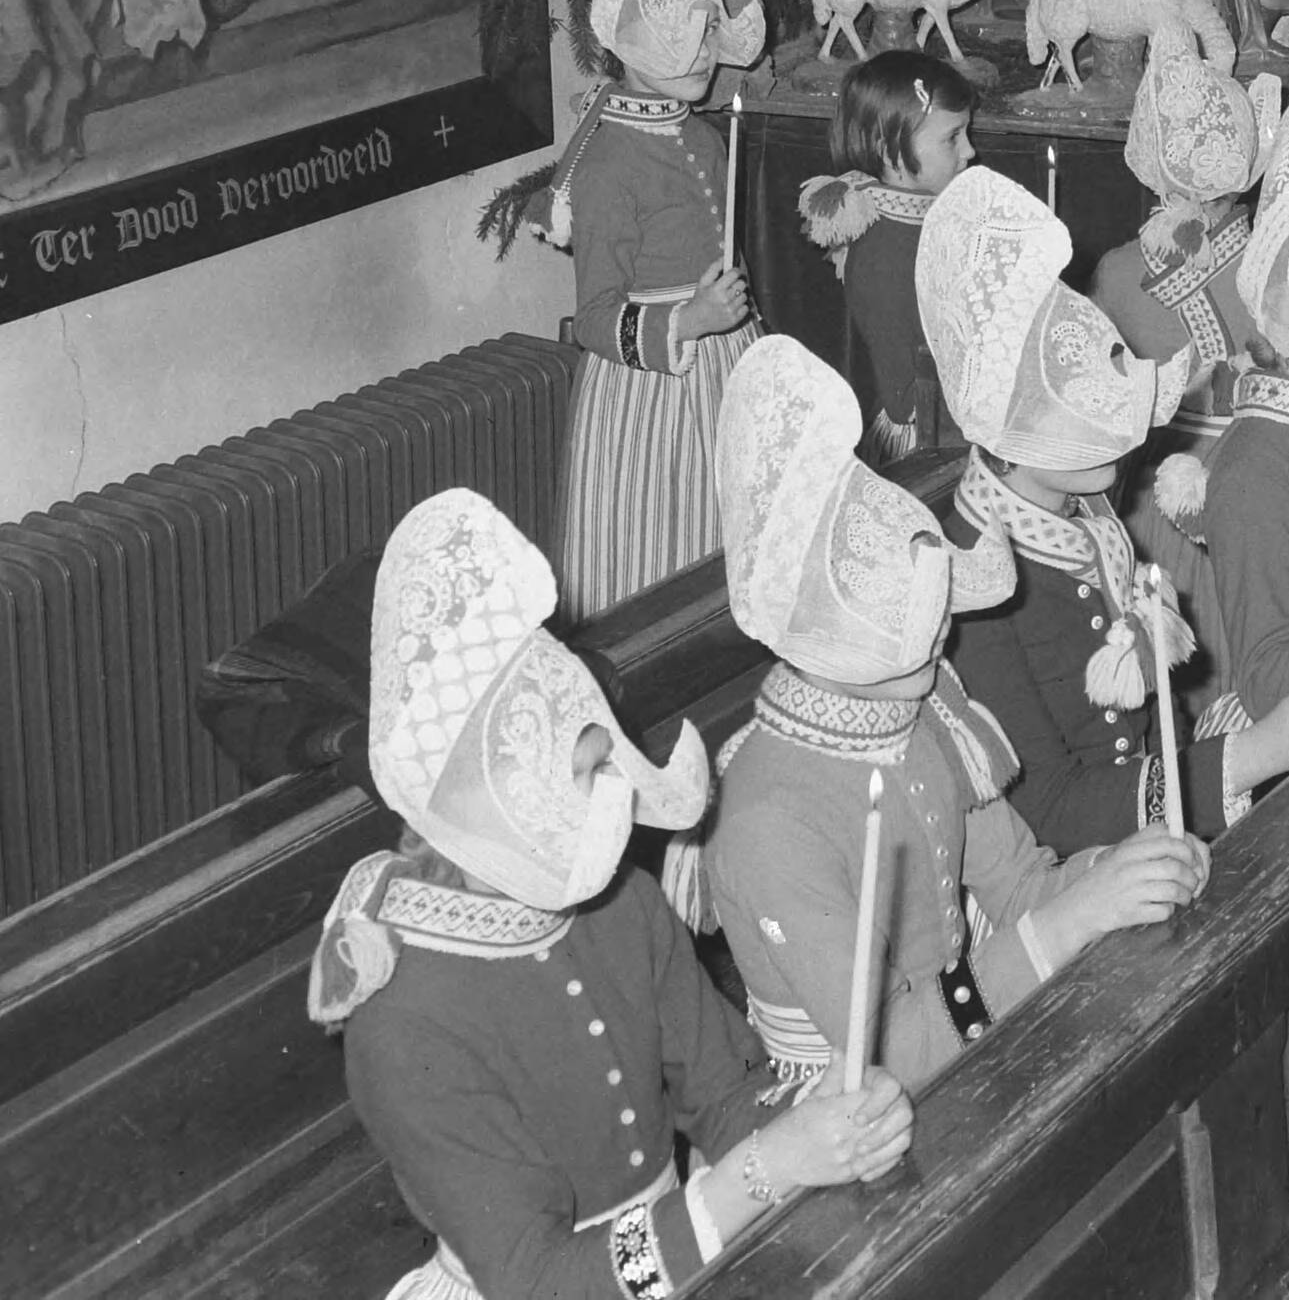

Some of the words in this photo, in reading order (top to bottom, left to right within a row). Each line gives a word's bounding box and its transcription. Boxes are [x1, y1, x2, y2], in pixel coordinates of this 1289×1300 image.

[31, 224, 96, 273] Ter
[113, 190, 199, 252] Dood
[217, 129, 392, 220] Veroordeeld
